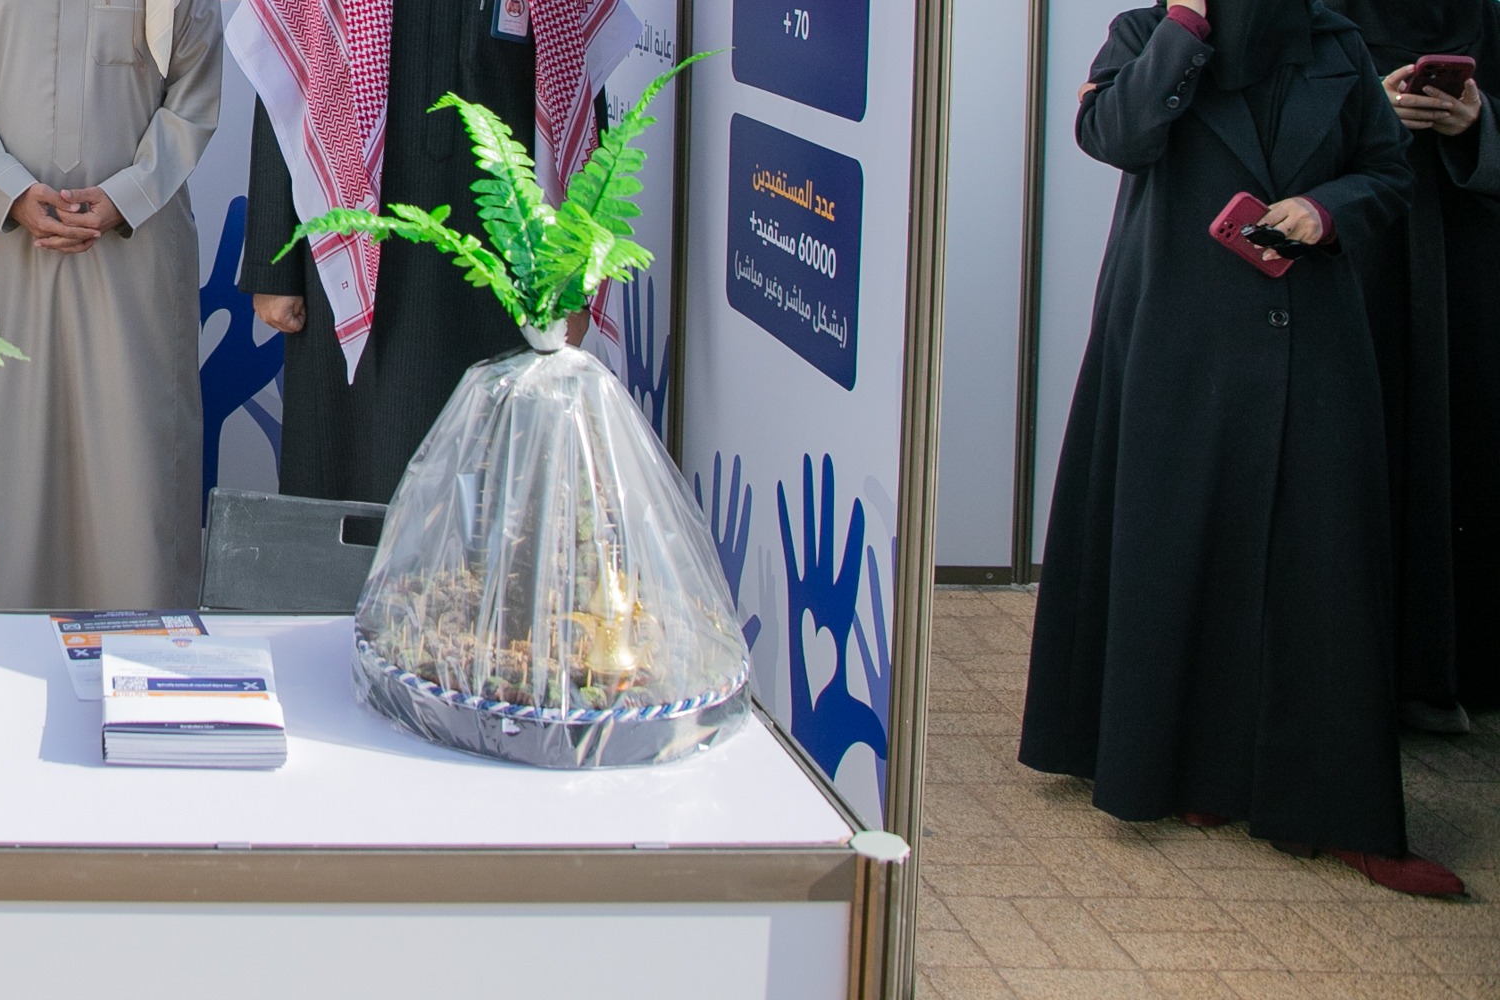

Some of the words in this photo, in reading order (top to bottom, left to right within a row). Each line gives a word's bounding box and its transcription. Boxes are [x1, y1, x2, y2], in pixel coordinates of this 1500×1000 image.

[794, 9, 810, 40] 70
[752, 163, 813, 211] المستفيدين
[814, 194, 835, 221] عدد
[798, 232, 836, 279] 60000
[763, 277, 784, 309] وغير
[784, 285, 811, 323] مباشر
